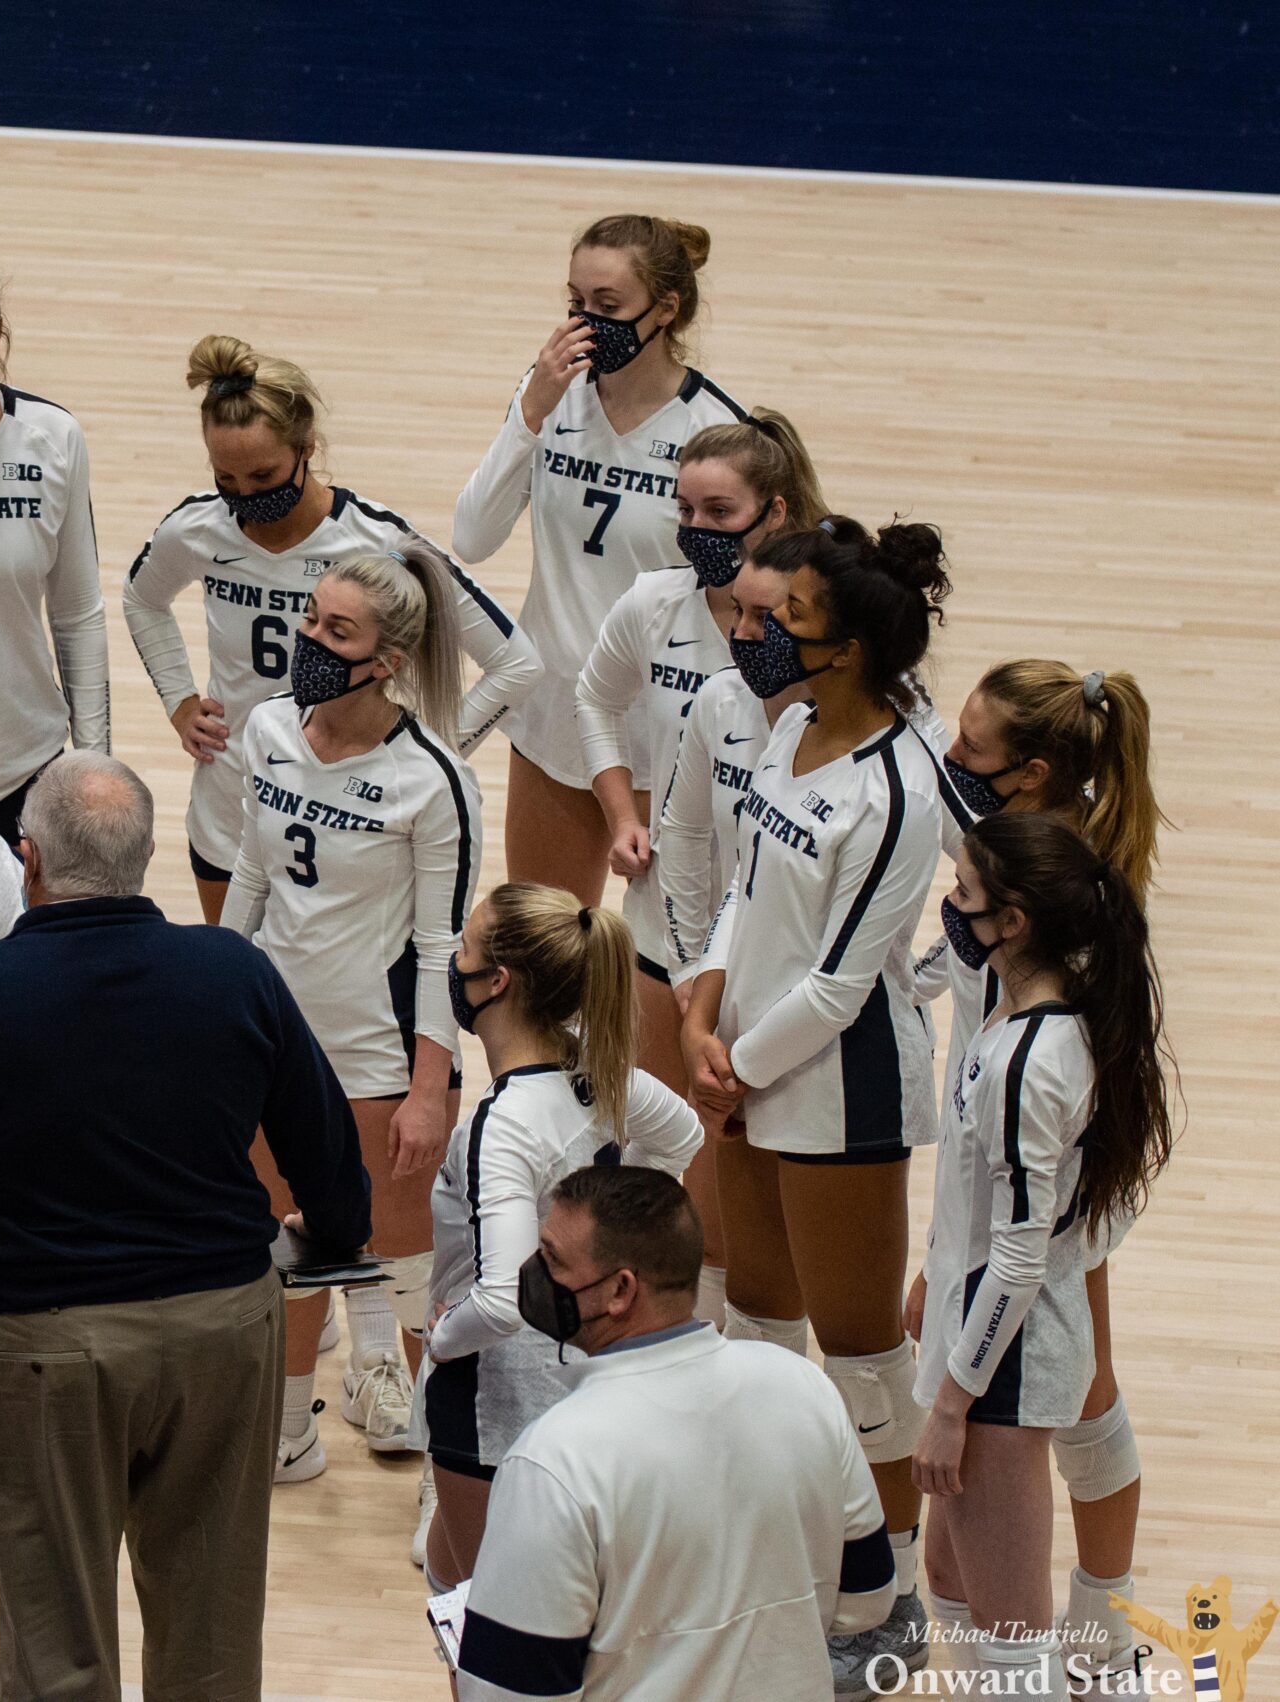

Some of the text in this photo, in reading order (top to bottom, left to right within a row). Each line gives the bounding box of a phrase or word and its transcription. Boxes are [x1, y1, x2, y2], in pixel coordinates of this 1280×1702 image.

[583, 487, 621, 557] 7
[204, 575, 262, 608] PENN
[251, 614, 289, 680] 6
[253, 774, 385, 832] PENN STATE
[761, 805, 818, 860] STATE
[284, 822, 319, 888] 3
[970, 1293, 1011, 1370] NITTANY LIONS
